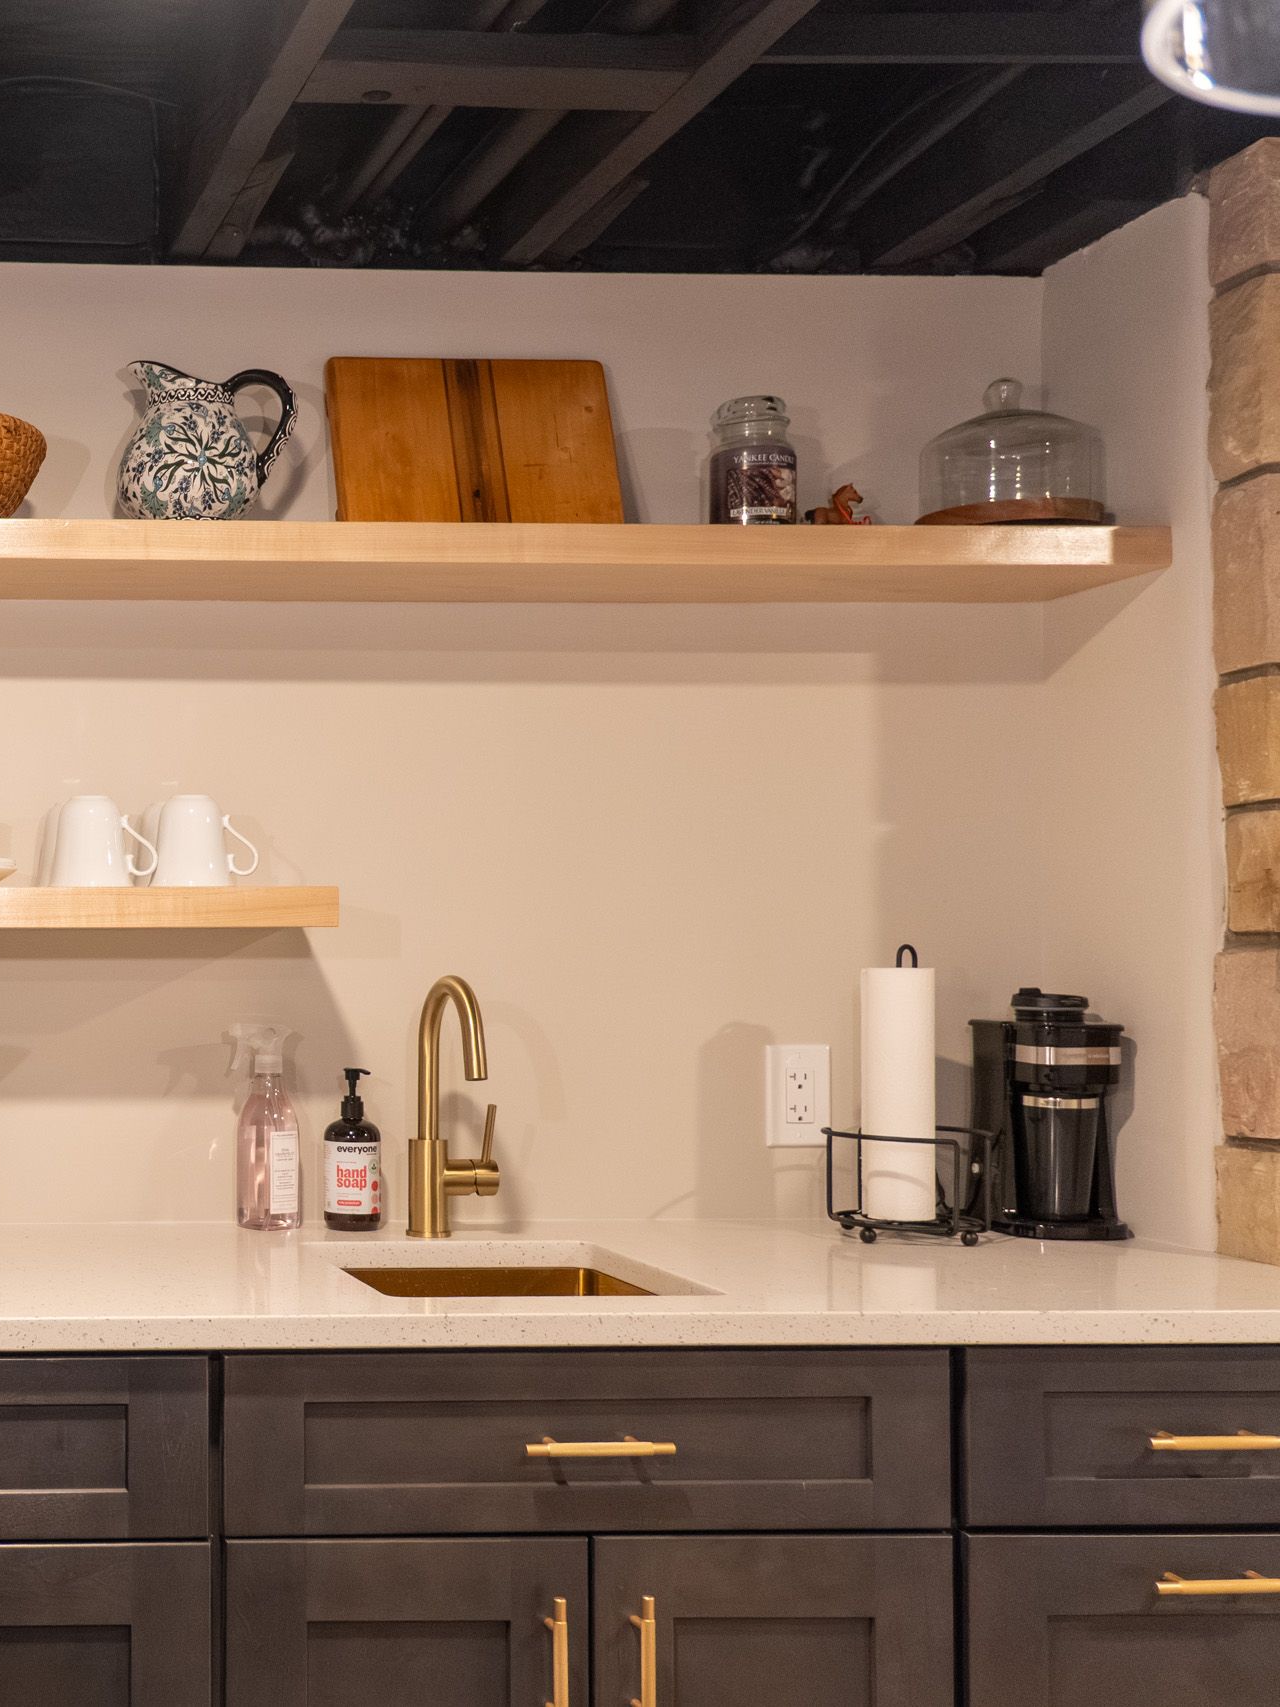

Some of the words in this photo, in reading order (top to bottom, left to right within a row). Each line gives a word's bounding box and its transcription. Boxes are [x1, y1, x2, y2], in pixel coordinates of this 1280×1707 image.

[733, 453, 767, 464] YANKEE
[336, 1145, 378, 1155] everyone
[336, 1164, 367, 1178] hand
[336, 1178, 367, 1191] soap
